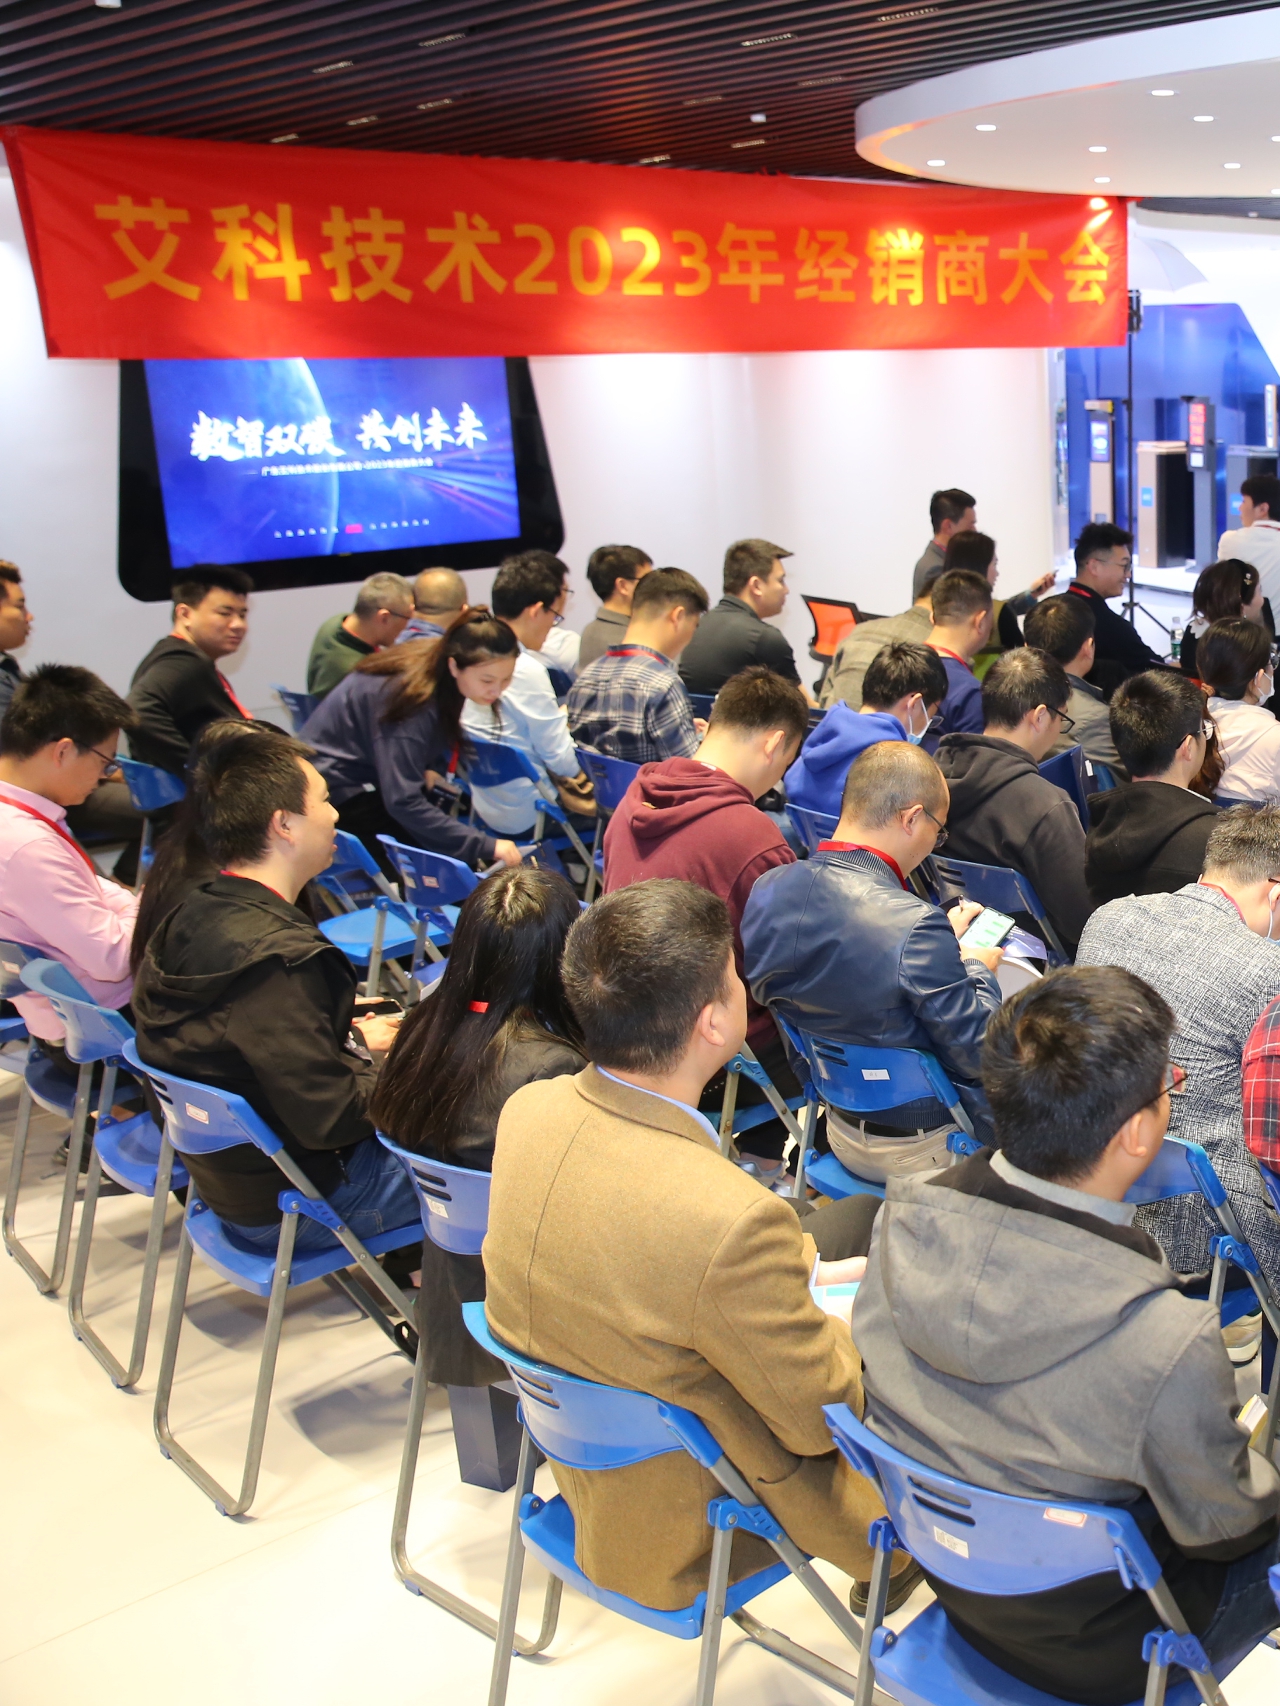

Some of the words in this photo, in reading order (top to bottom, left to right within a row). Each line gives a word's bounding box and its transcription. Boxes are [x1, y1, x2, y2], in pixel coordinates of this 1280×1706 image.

[94, 195, 1111, 306] 艾科技术2023年经销商大会
[355, 402, 488, 452] 共创未来
